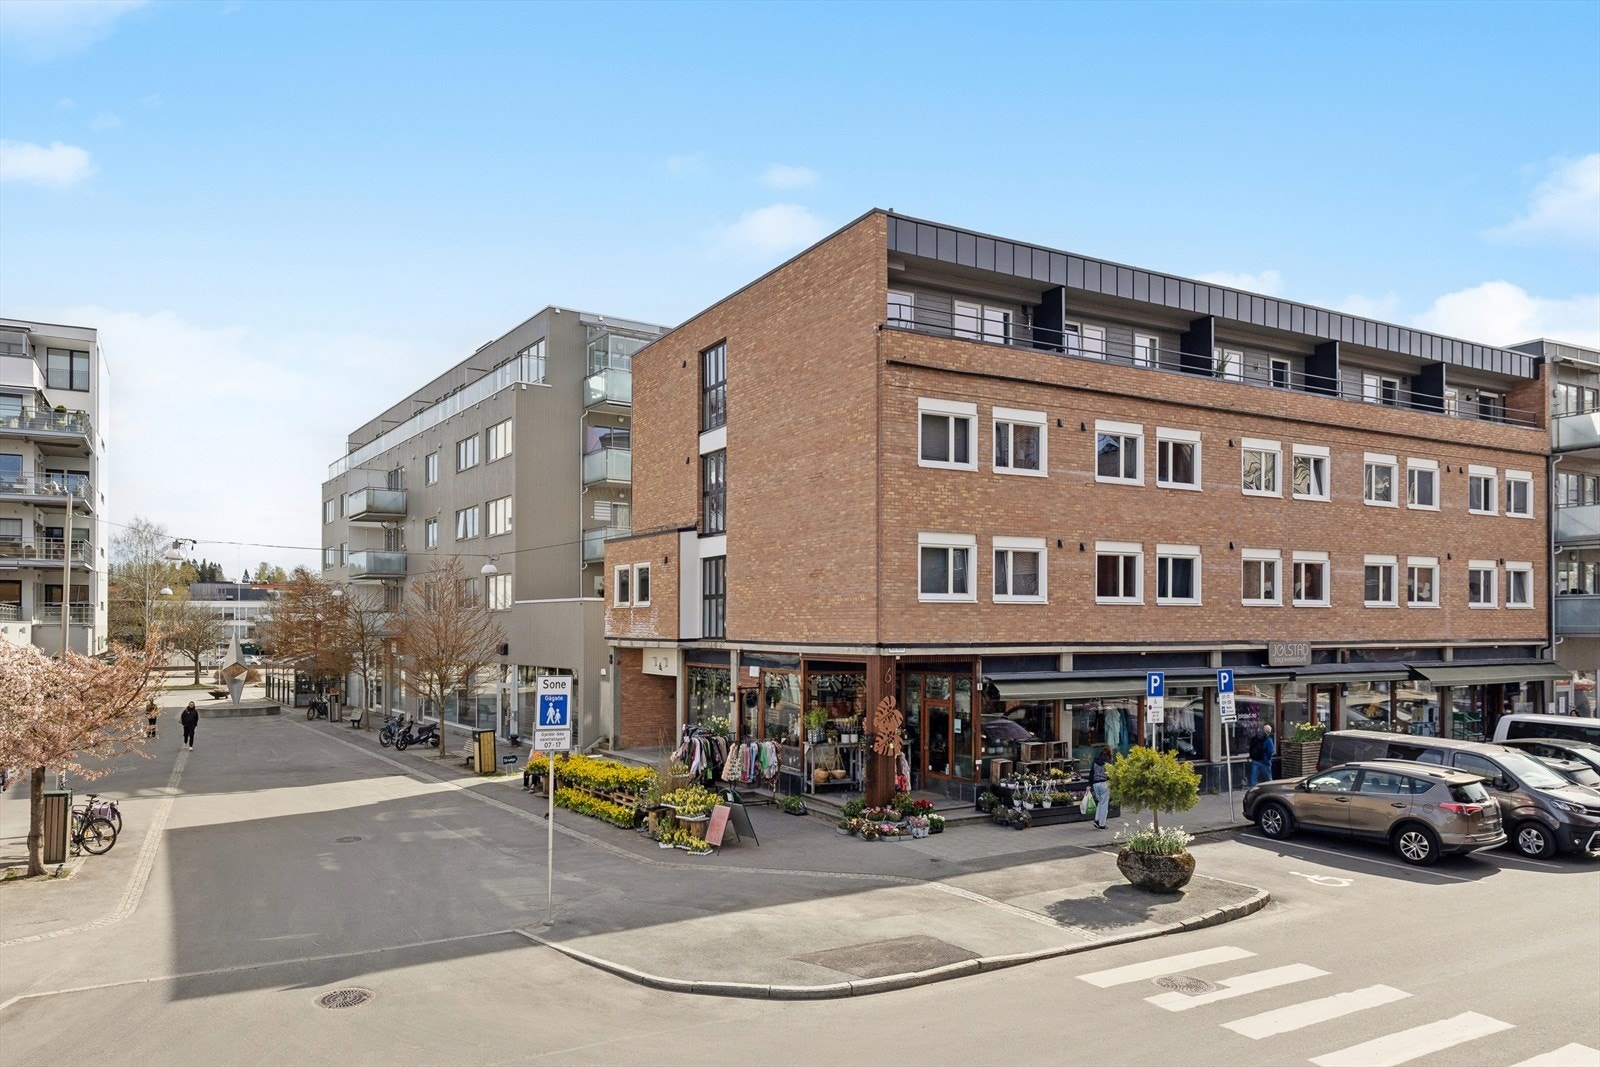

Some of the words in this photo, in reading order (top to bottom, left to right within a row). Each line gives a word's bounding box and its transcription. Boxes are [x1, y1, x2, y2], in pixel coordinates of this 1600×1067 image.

[1272, 643, 1309, 657] JØLSTAD
[885, 667, 892, 683] 6
[1220, 672, 1229, 690] P
[542, 679, 567, 690] Sone
[1151, 675, 1160, 694] P
